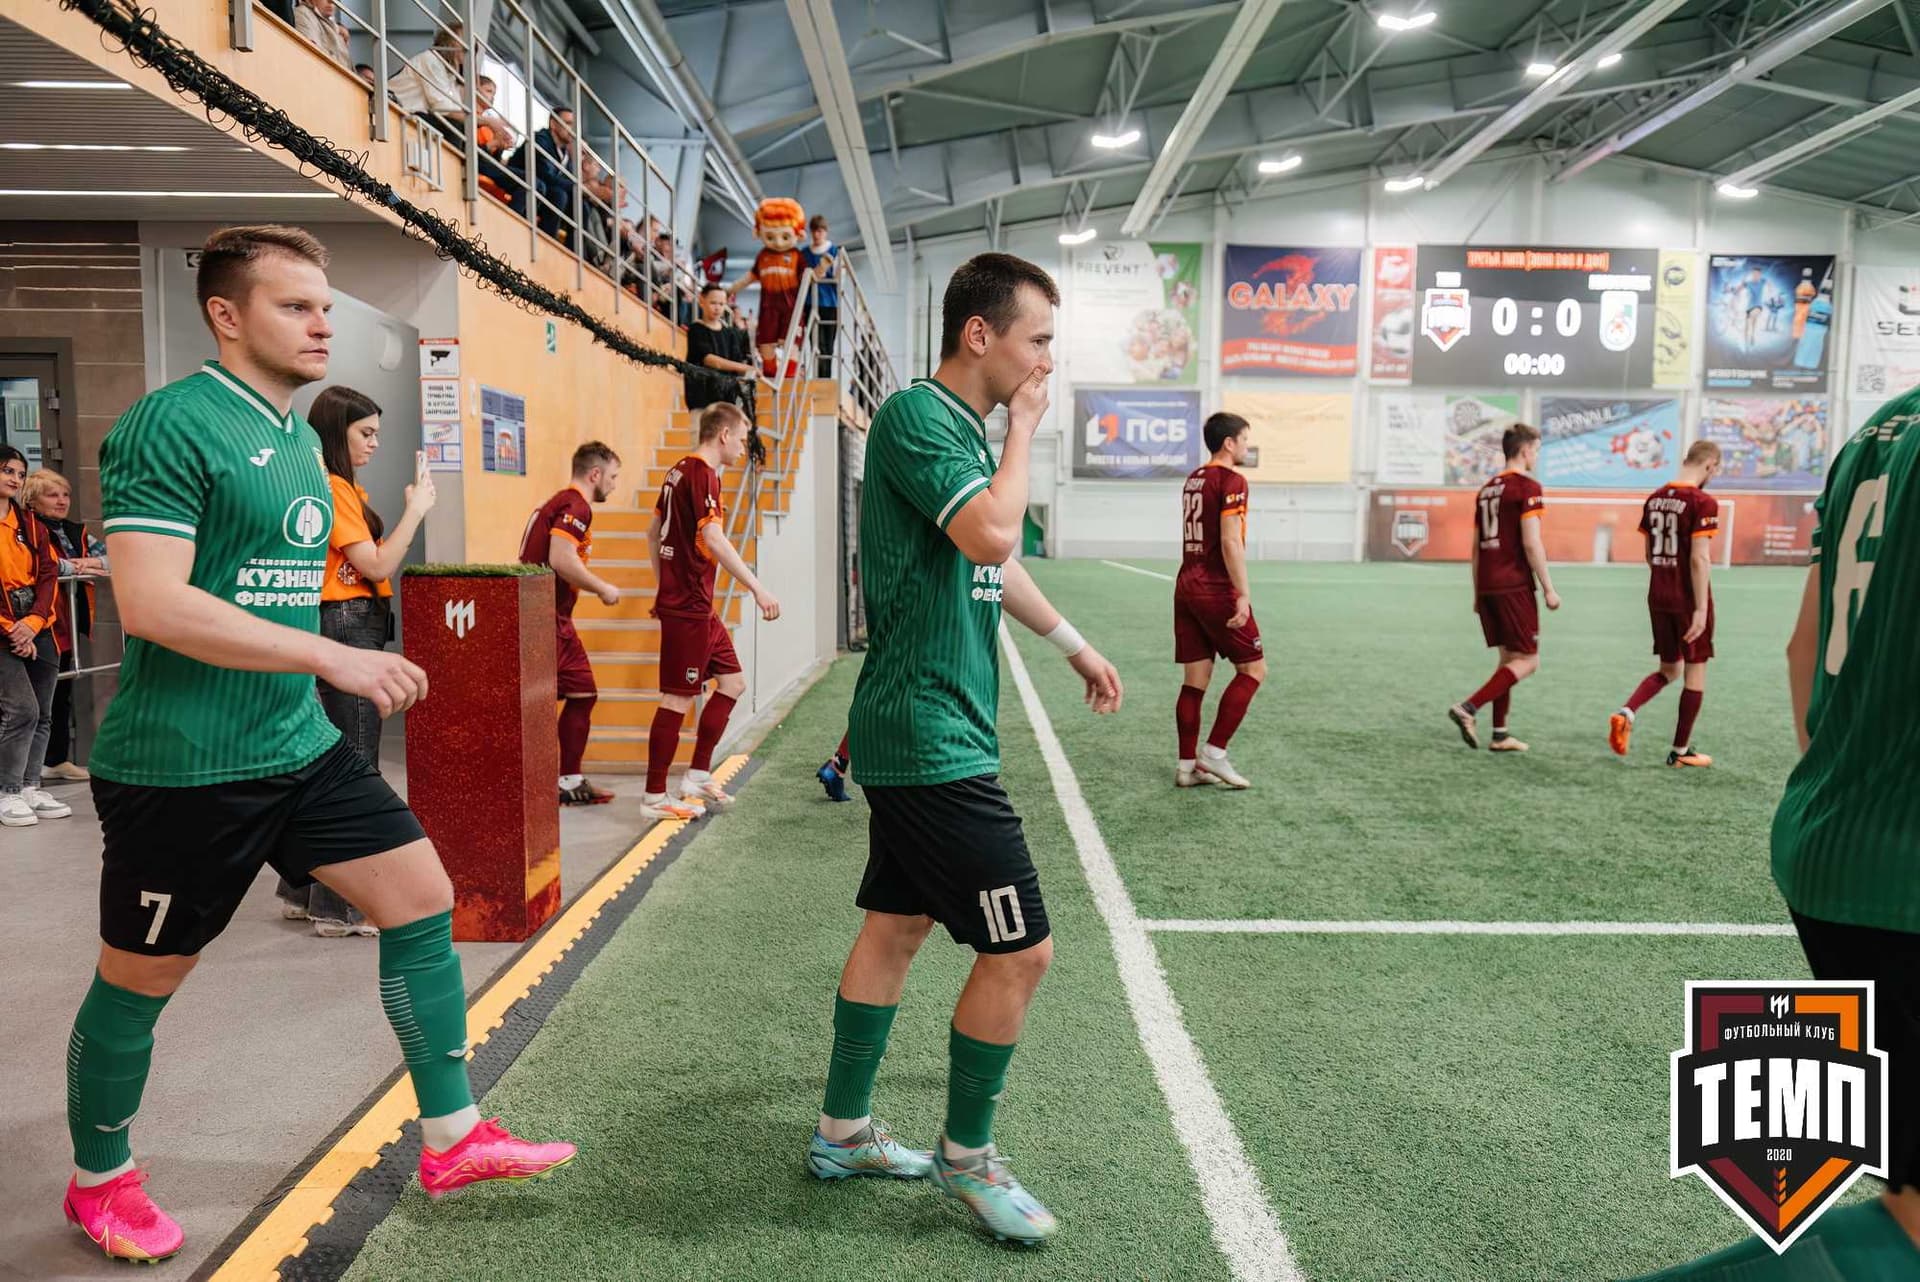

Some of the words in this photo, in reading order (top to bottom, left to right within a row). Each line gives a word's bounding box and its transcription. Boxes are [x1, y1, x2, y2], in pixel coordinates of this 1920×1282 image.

[1227, 281, 1357, 311] GALAXY
[1492, 297, 1518, 336] 0
[1555, 298, 1582, 337] 0
[1877, 321, 1920, 336] SE
[1504, 353, 1565, 376] 00:00
[1126, 418, 1187, 442] ПСБ
[1183, 492, 1204, 541] 22
[1649, 511, 1678, 556] 33
[140, 891, 171, 945] 7
[979, 885, 1027, 943] 10
